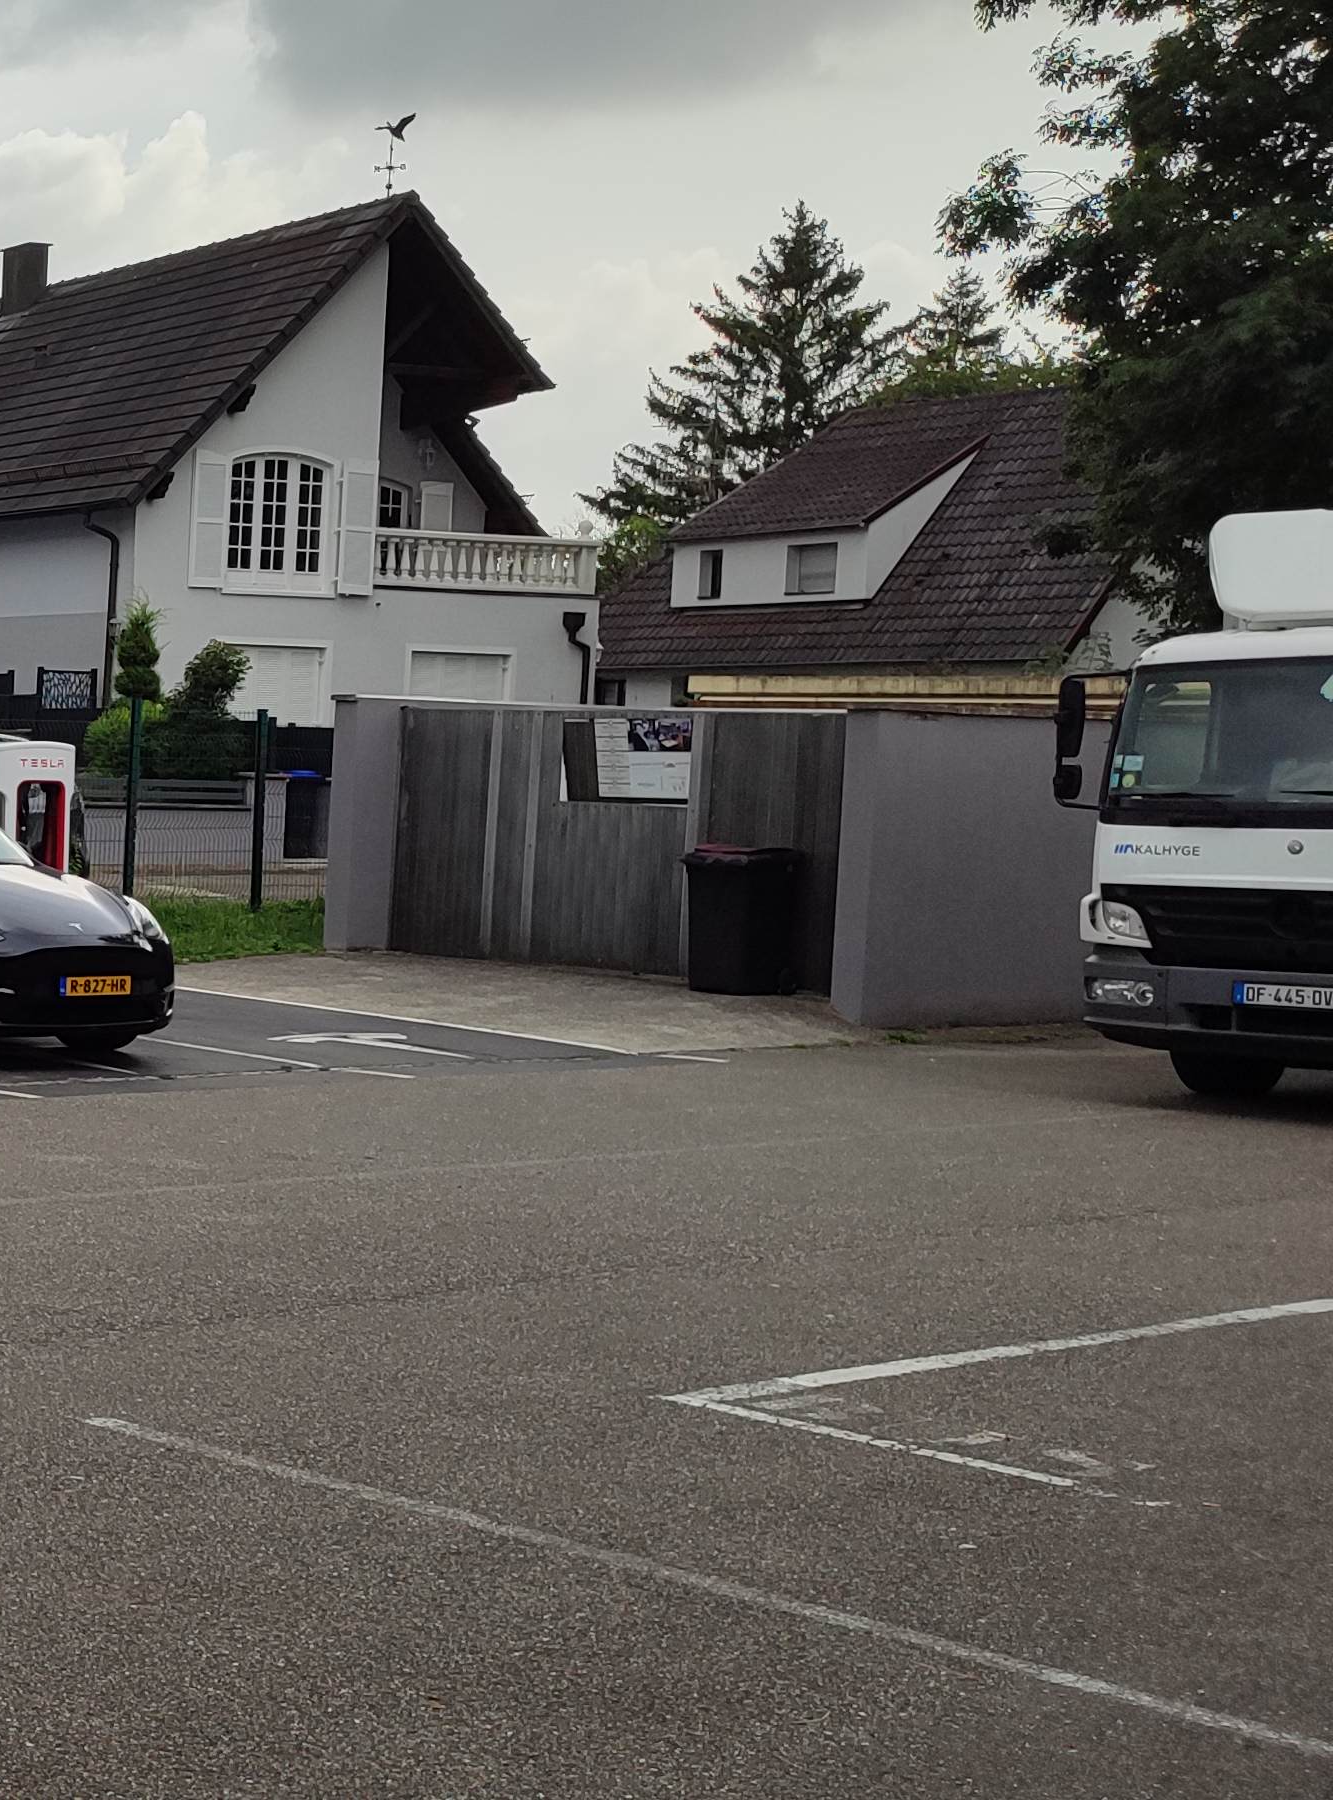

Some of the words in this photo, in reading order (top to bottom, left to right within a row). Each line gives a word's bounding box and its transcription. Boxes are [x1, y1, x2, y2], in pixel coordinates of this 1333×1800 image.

[20, 758, 65, 768] TESLA
[1134, 844, 1200, 857] KALHYGE
[70, 979, 126, 993] R-827-HR
